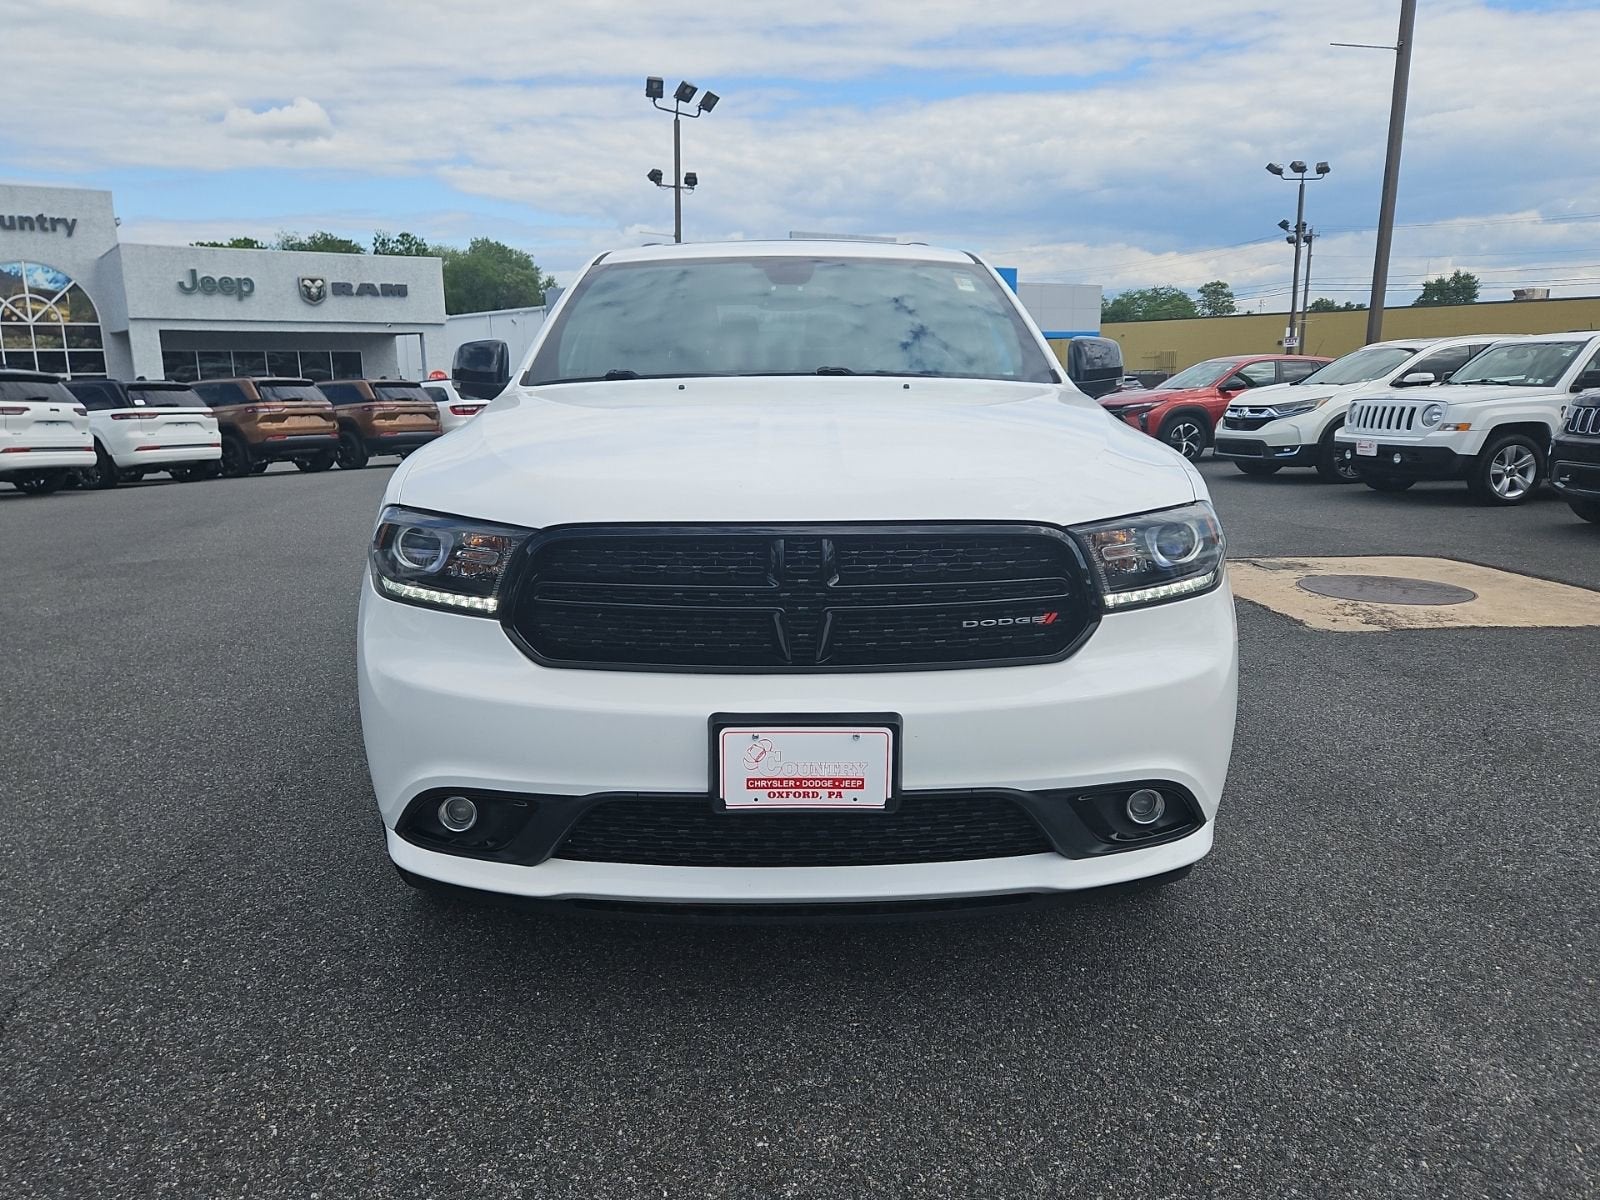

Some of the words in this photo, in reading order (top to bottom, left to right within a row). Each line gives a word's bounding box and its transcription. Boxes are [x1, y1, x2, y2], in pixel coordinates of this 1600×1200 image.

[177, 268, 255, 301] Jeep
[331, 281, 408, 297] RAM
[962, 615, 1047, 628] DODGE
[747, 780, 795, 788] CHRYSLER
[802, 780, 833, 788] DODGE
[840, 780, 863, 788] JEEP
[767, 790, 823, 800] OXFORD,
[827, 790, 844, 799] PA
